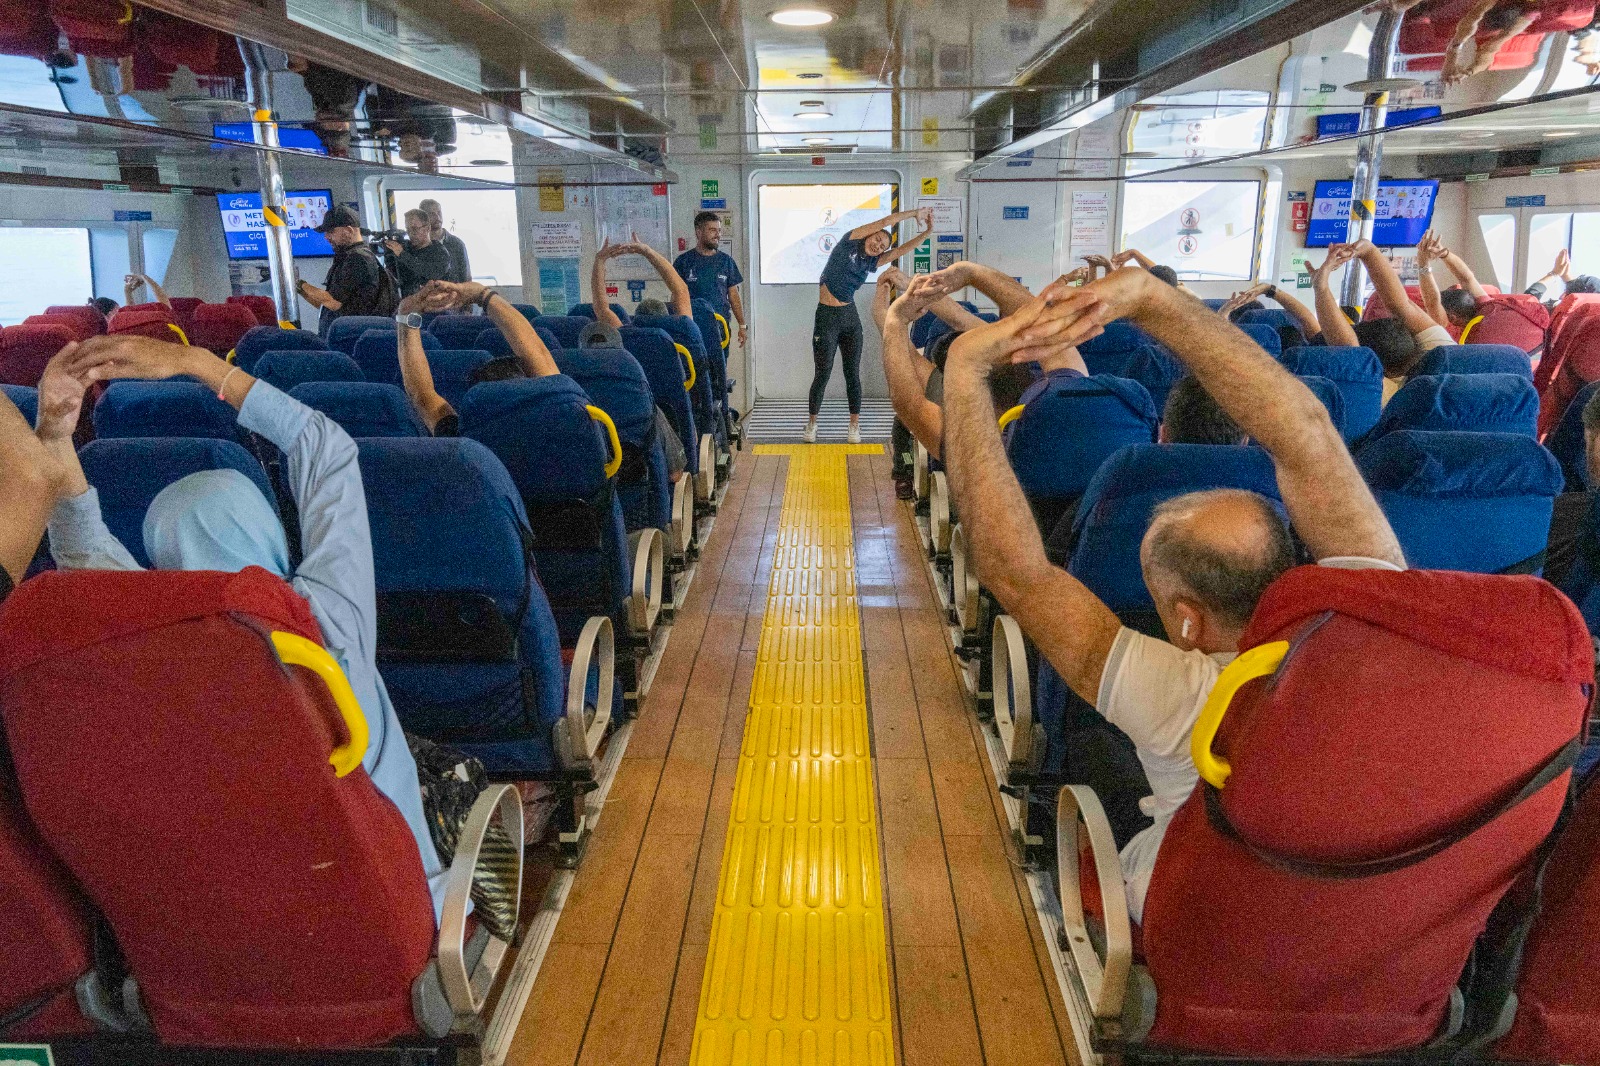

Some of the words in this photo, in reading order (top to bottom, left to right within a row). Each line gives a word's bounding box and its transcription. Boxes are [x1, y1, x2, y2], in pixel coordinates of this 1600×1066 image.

[702, 184, 718, 192] Exit
[915, 261, 929, 269] EXIT
[1298, 277, 1311, 285] EXIT
